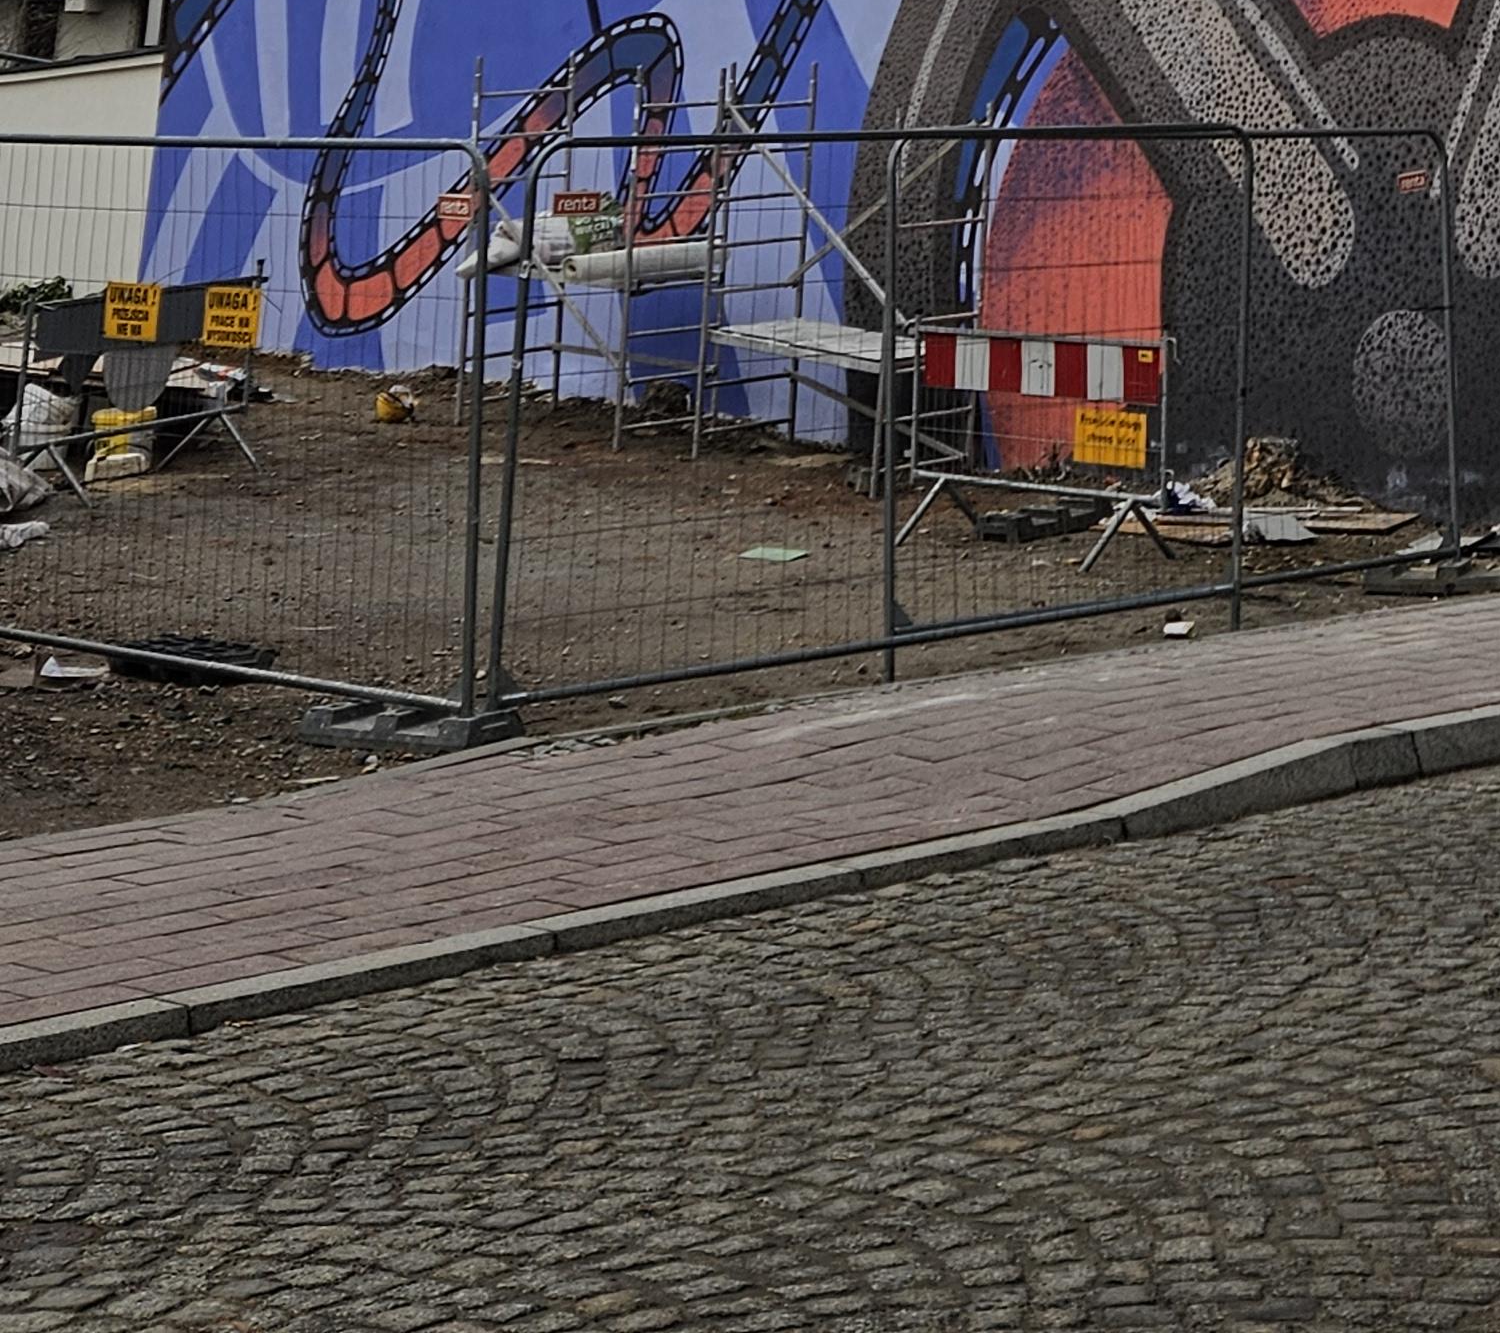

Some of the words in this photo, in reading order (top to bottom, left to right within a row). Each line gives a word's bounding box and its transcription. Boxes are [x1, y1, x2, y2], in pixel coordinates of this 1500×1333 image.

[557, 196, 597, 212] renta
[109, 286, 149, 306] UWAGA
[208, 291, 249, 310] UWAGA
